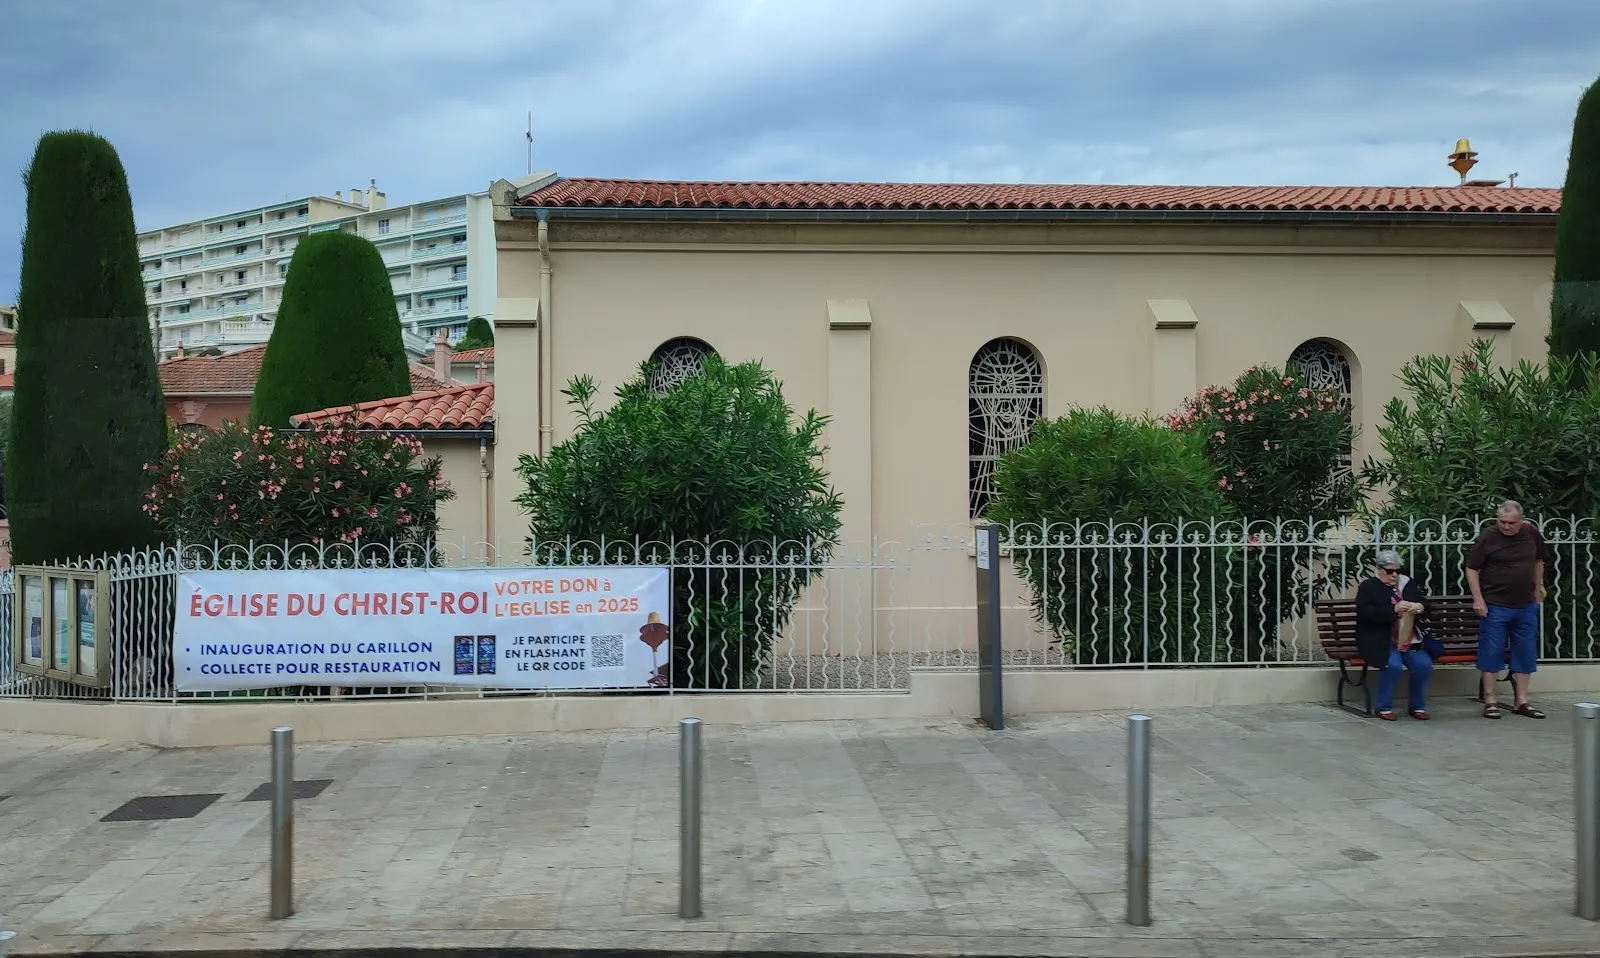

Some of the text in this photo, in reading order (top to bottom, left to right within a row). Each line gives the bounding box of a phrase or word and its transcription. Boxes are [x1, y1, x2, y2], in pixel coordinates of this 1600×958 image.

[495, 578, 611, 596] VOTRE DON à
[190, 587, 488, 617] ÉGLISE DU CHRIST-ROI
[495, 597, 639, 617] L'EGLISE en 2025
[512, 635, 585, 646] JE PARTICIPE
[201, 641, 432, 655] INAUGURATION DU CARILLON
[505, 648, 585, 659] EN FLASHANT
[201, 661, 441, 675] COLLECTE POUR RESTAURATION
[517, 661, 585, 671] LE QR CODE
